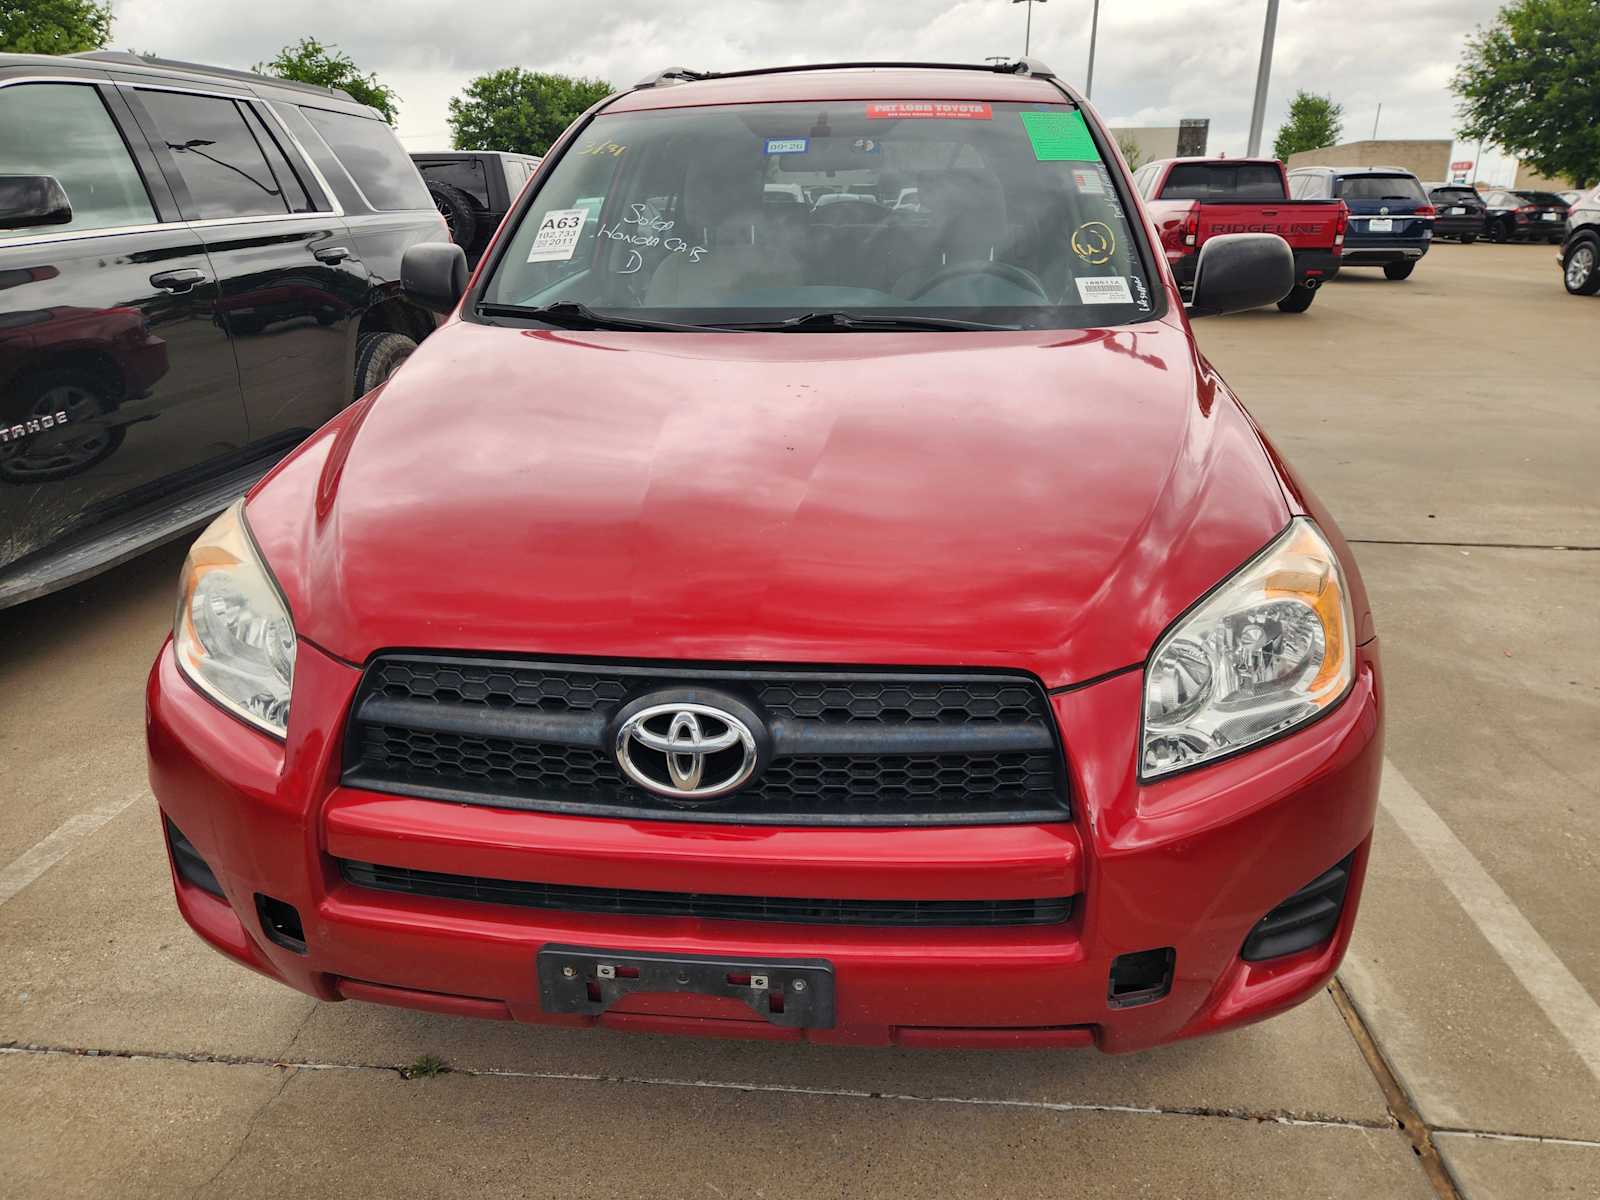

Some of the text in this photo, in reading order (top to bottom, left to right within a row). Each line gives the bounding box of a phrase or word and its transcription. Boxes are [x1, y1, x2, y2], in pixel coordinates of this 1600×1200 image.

[541, 216, 580, 231] A63
[1210, 223, 1321, 234] RIDGELINE
[0, 410, 69, 442] TAHOE
